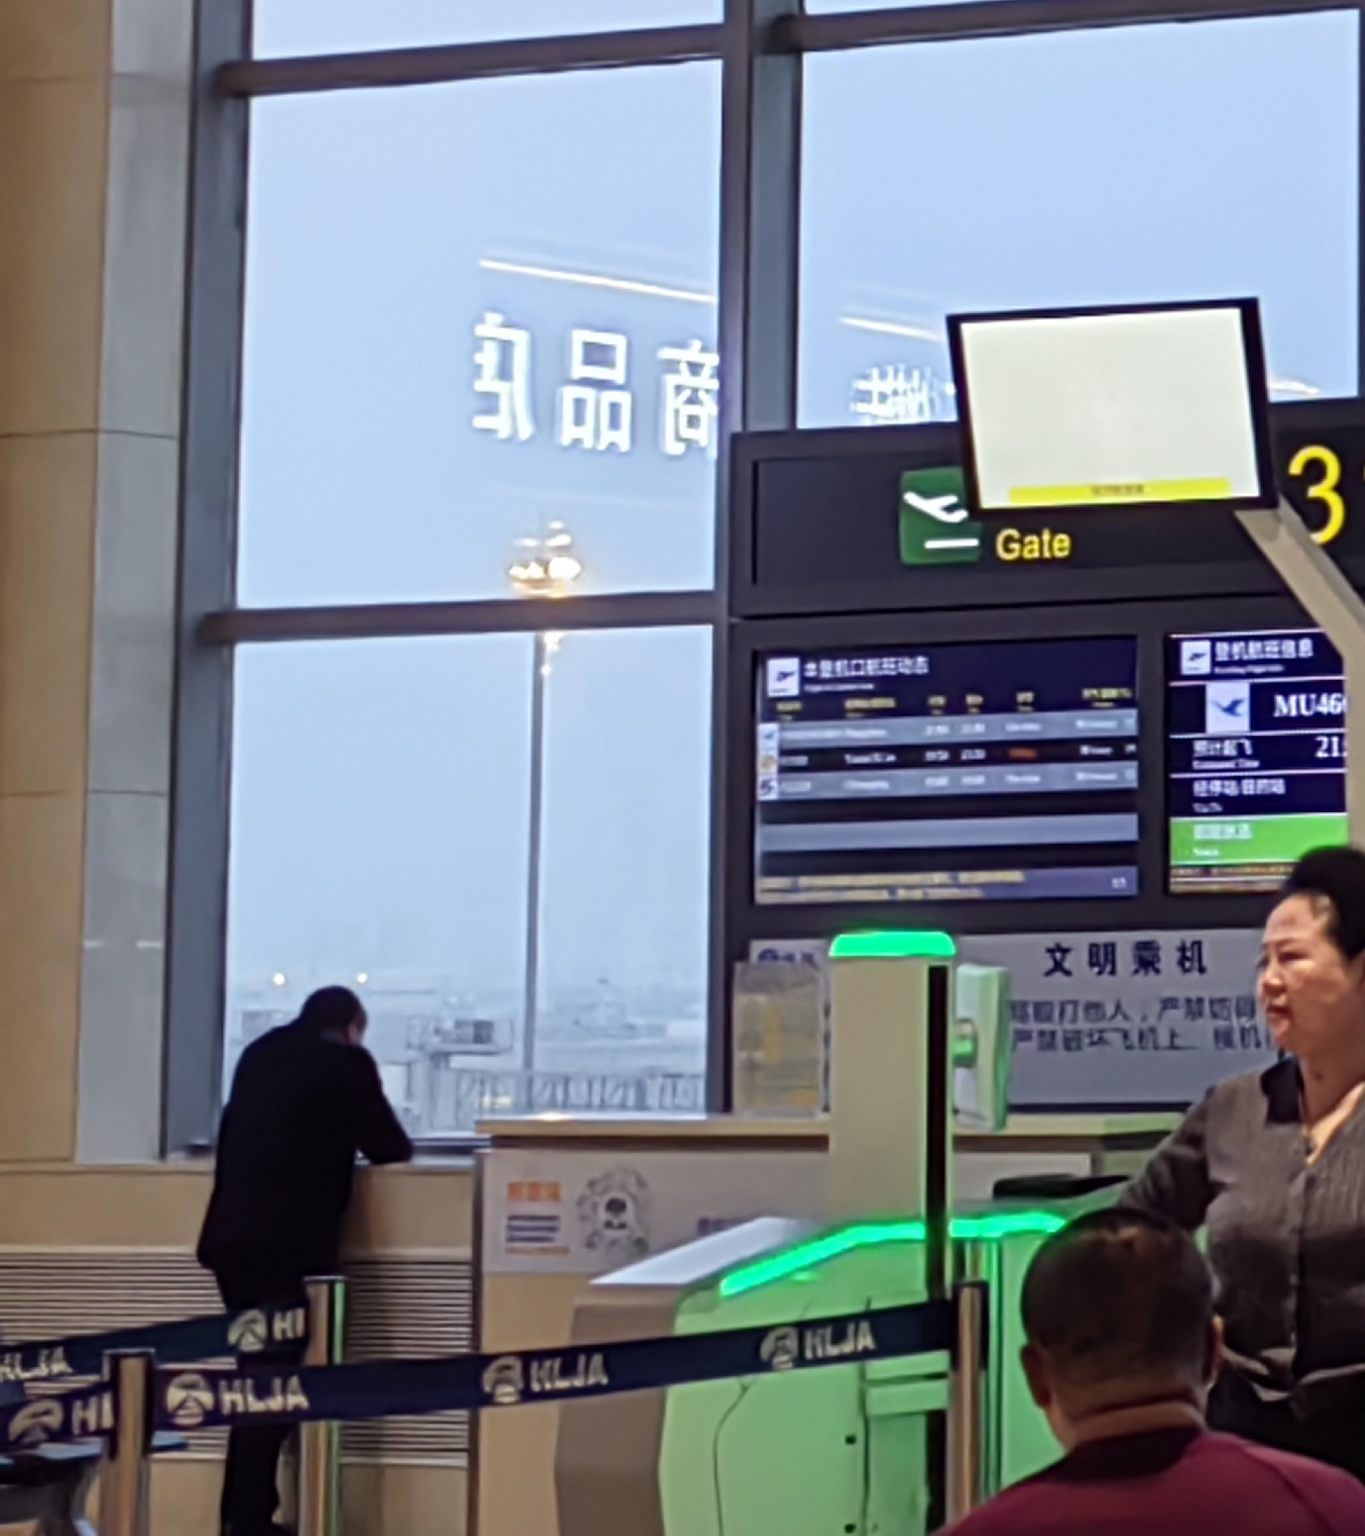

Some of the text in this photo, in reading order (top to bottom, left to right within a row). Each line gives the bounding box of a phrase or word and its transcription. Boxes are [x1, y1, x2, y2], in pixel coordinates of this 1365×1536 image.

[995, 527, 1072, 561] Gate
[1042, 938, 1208, 977] 文明乘机
[803, 1320, 877, 1360] HLJA
[528, 1353, 610, 1393] HLJA
[219, 1374, 310, 1416] HLJA
